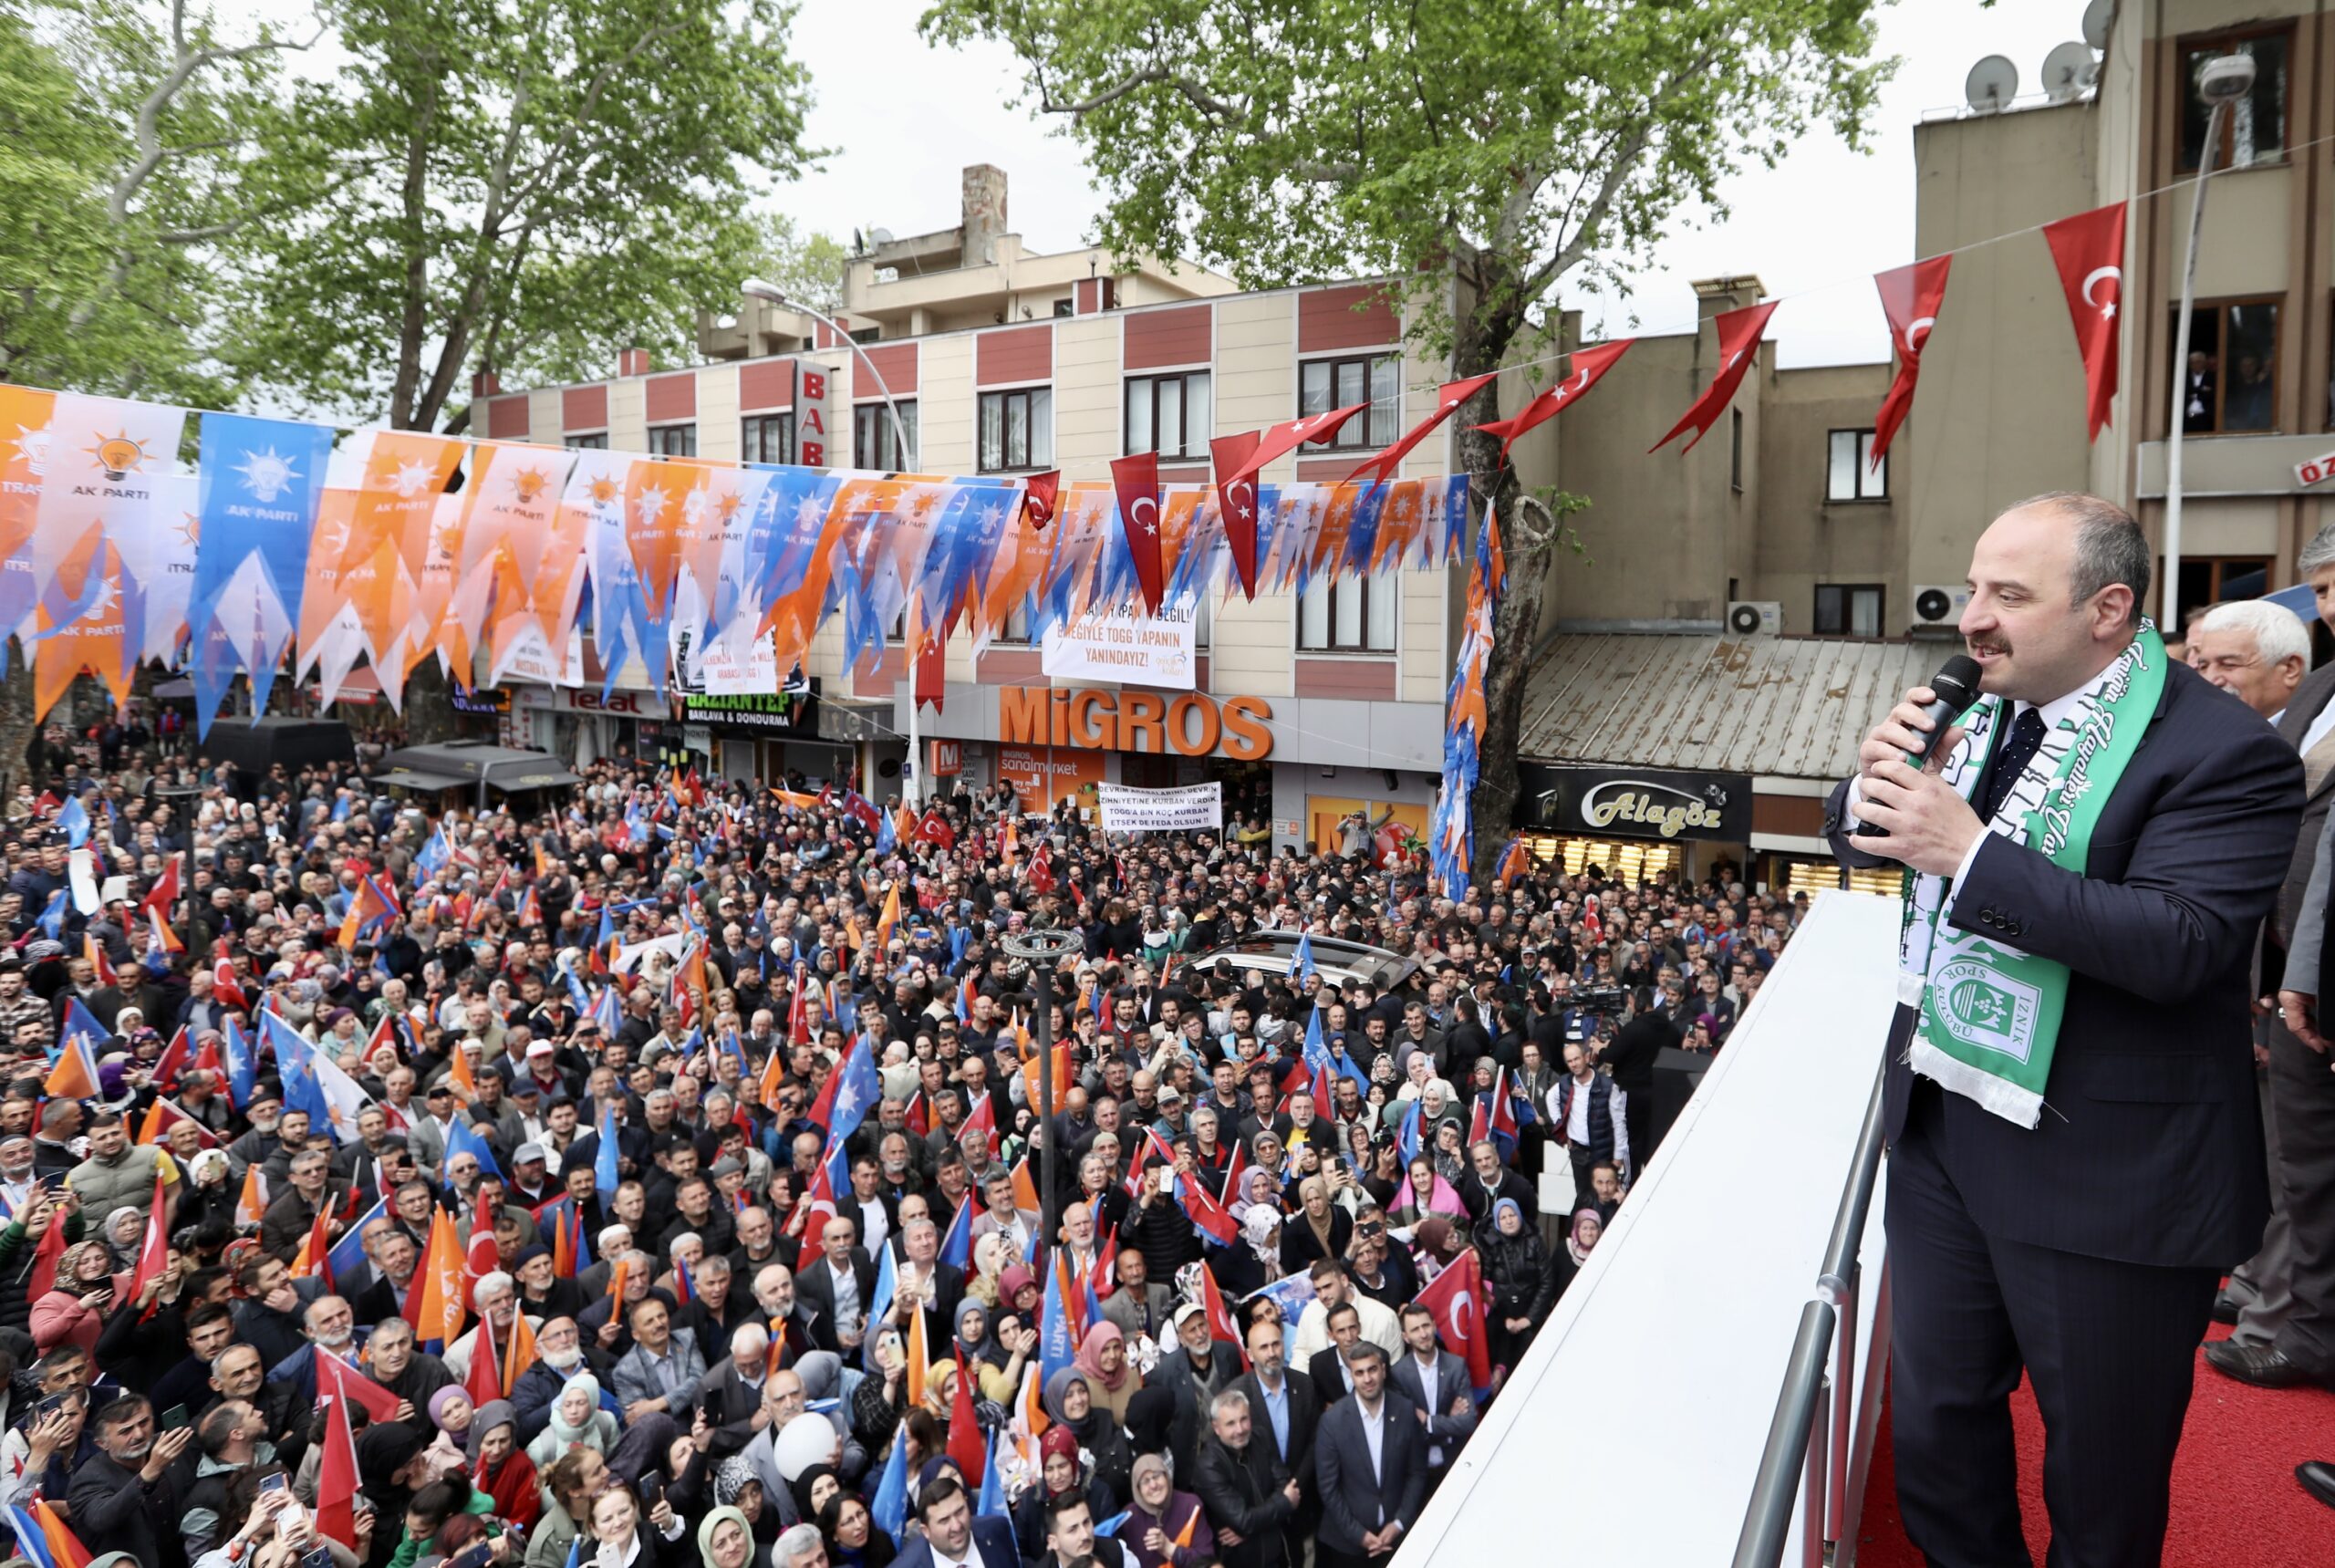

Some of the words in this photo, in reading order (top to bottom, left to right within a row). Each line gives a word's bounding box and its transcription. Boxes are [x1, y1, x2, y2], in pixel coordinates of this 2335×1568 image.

[72, 485, 97, 497] AK
[1107, 628, 1133, 644] TOGG
[688, 710, 725, 722] BAKLAVA
[727, 711, 734, 722] &
[736, 712, 789, 726] DONDURMA
[1152, 796, 1186, 805] KURBAN
[1174, 806, 1209, 815] KURBAN
[1593, 792, 1722, 838] Alagöz
[1111, 818, 1137, 826] ETSEK
[1138, 818, 1149, 826] DE
[1151, 818, 1172, 826] FEDA
[1173, 816, 1202, 826] OLSUN
[1944, 964, 1988, 981] SPOR
[1935, 983, 1975, 1038] KULÜBÜ
